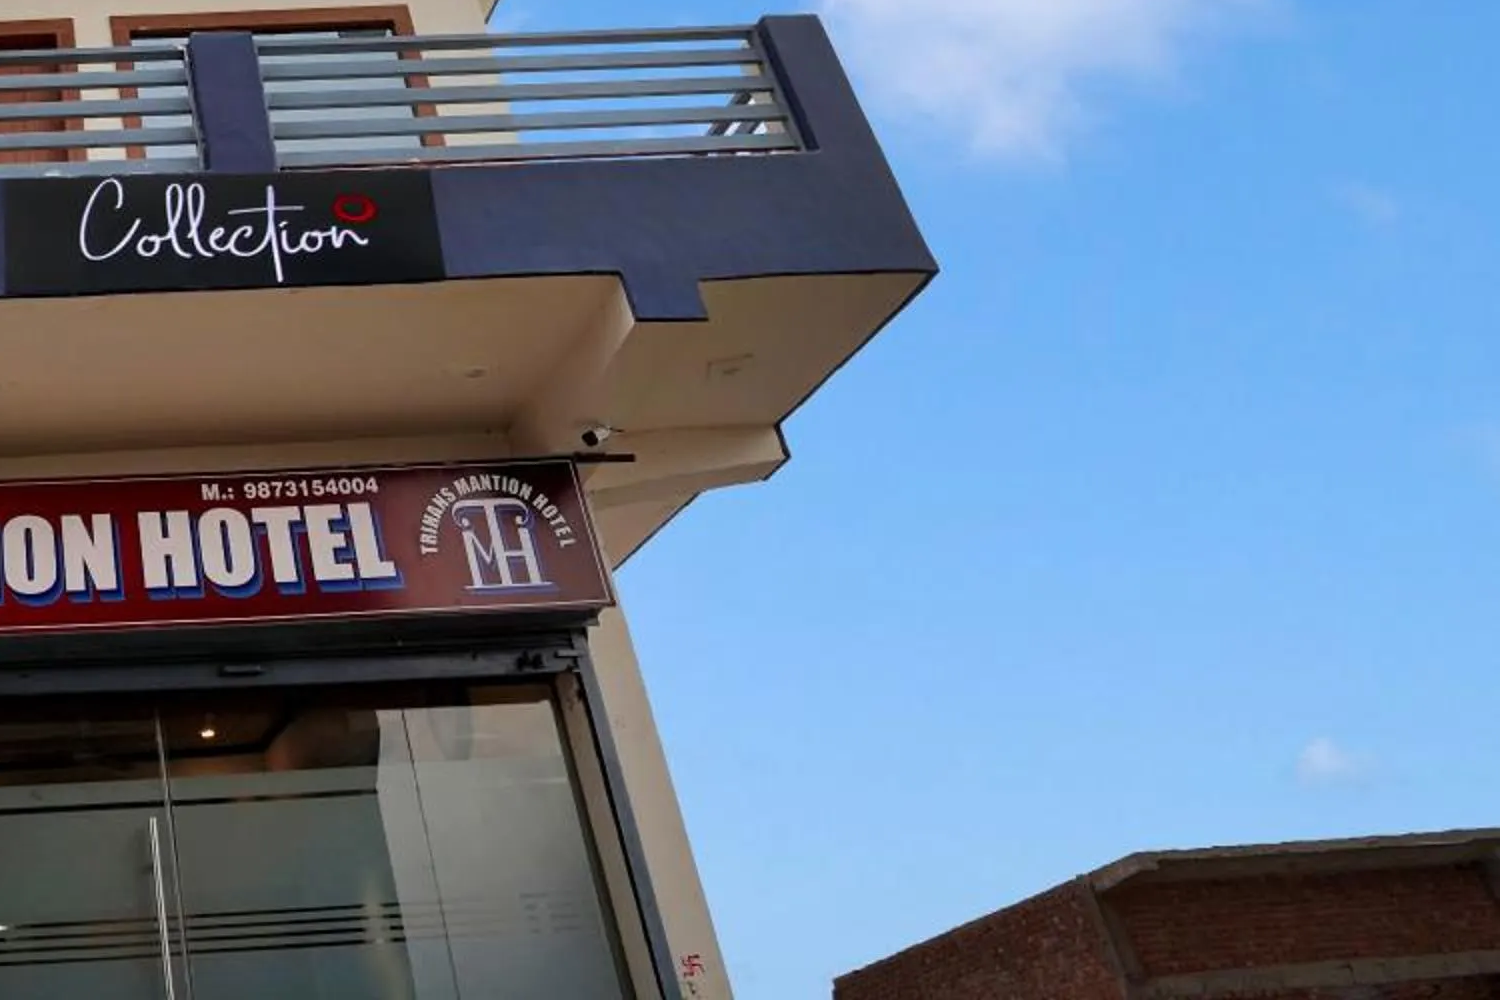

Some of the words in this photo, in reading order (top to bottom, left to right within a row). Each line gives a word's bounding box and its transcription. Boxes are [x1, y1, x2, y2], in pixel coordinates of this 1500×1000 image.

[78, 176, 369, 284] Collection
[243, 477, 379, 499] 9873154004
[420, 485, 457, 556] TRIHANS
[453, 473, 533, 502] MANTION
[532, 492, 576, 549] HOTEL
[137, 500, 404, 598] HOTEL
